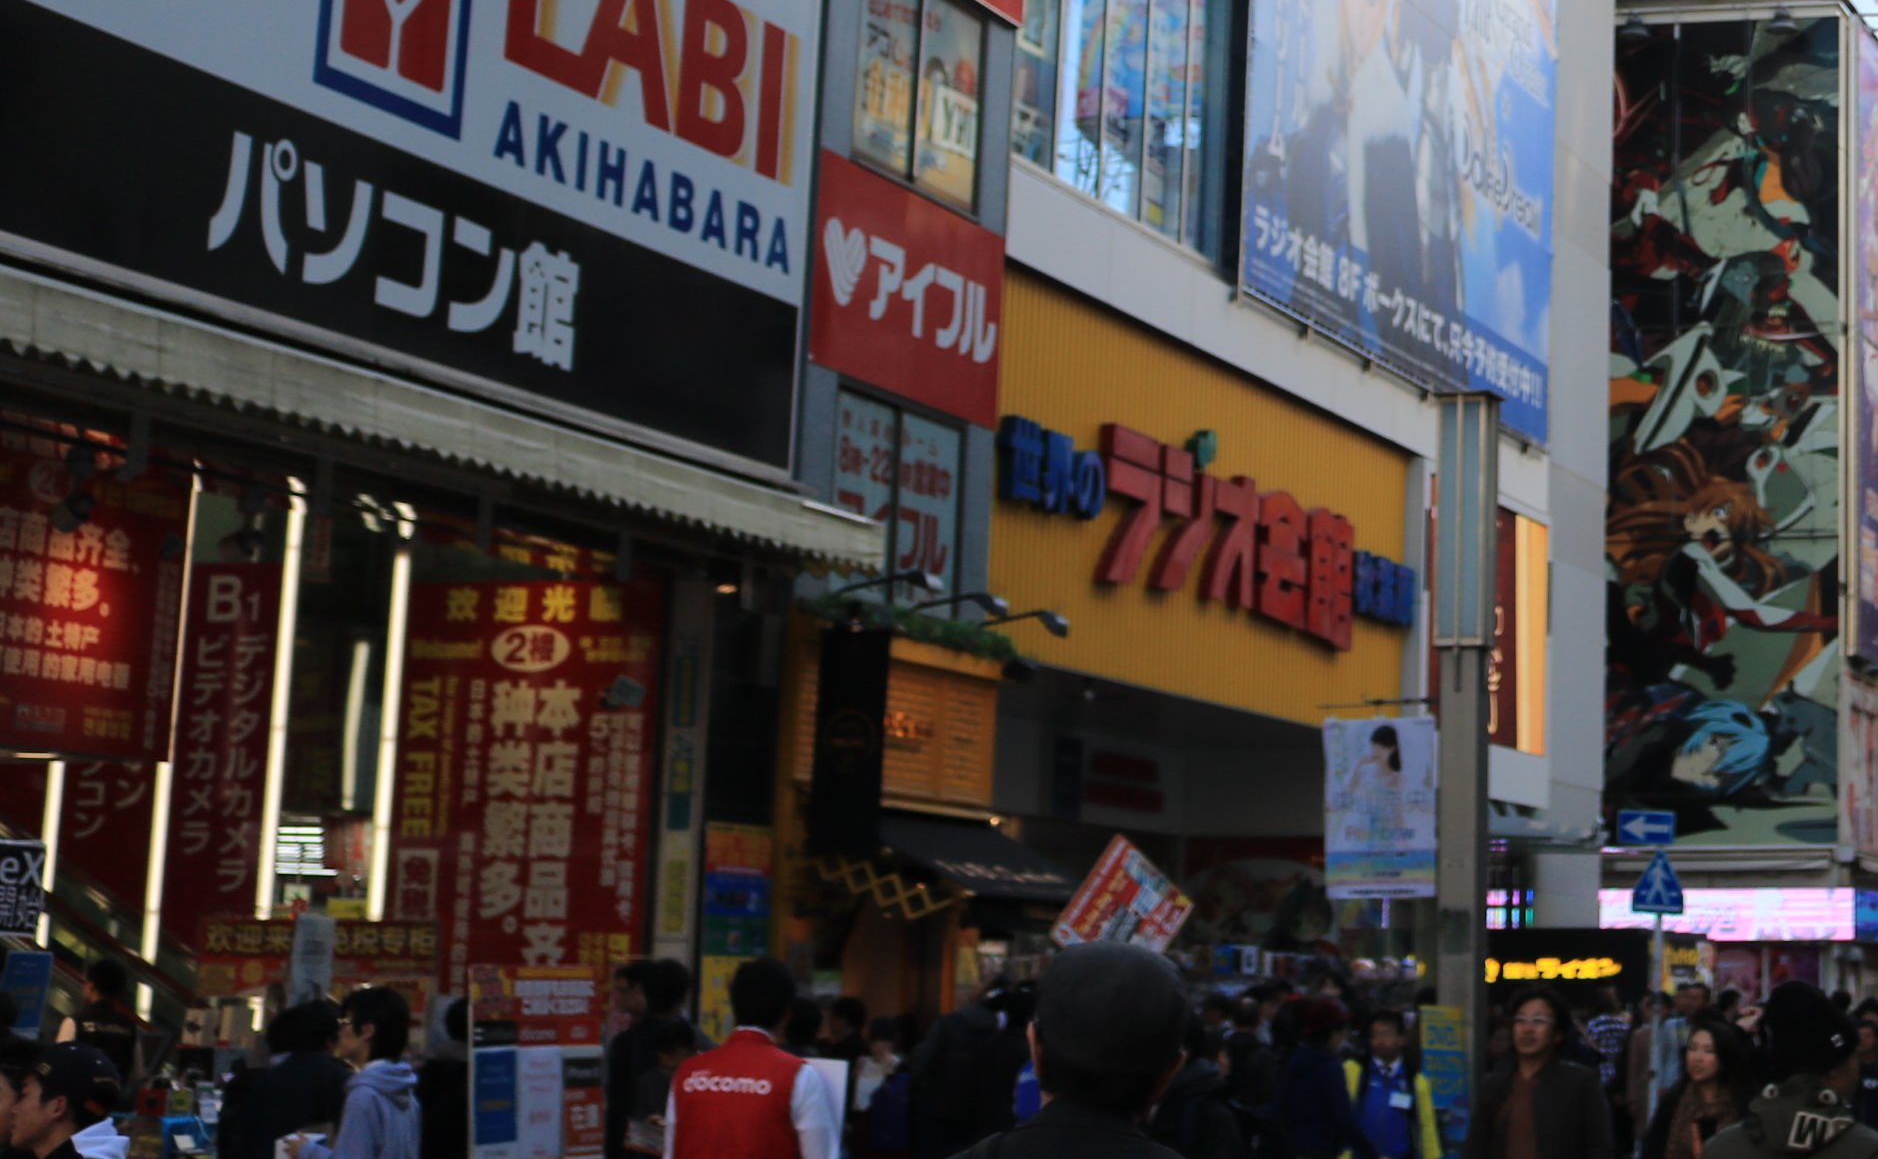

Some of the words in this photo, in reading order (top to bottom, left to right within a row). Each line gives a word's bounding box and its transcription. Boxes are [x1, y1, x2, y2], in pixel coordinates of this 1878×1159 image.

[208, 130, 583, 372] パソコン館
[493, 100, 792, 276] AKIHABARA
[1254, 203, 1337, 291] ラジオ会館
[868, 235, 998, 364] アイフル
[206, 572, 261, 624] B1
[1094, 421, 1356, 652] ラジオ会館
[178, 631, 230, 855] ビデオカメラ
[215, 634, 268, 894] デジタルカメラ
[408, 678, 442, 740] TAX
[402, 751, 438, 840] FREE
[682, 1069, 772, 1097] docomo
